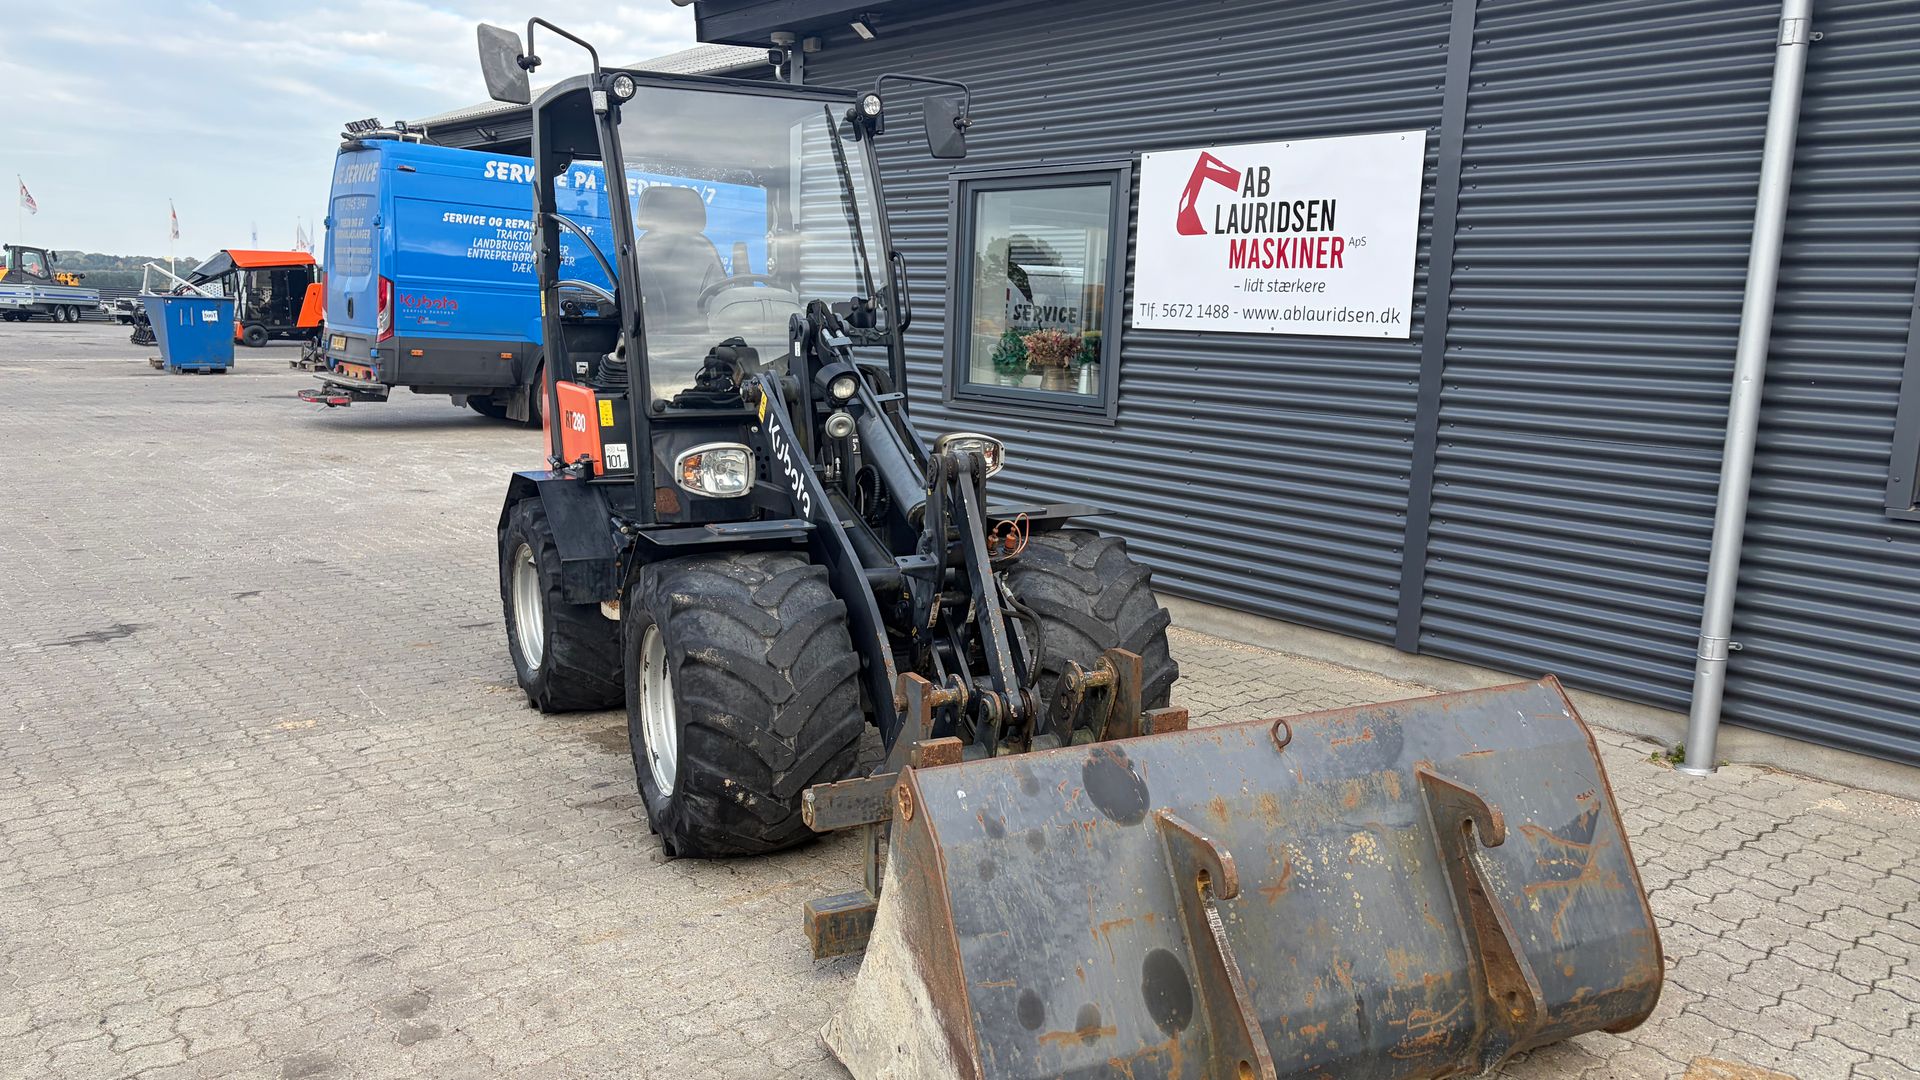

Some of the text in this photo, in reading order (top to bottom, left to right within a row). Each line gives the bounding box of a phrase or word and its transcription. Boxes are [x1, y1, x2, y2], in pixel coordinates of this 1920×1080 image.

[574, 170, 597, 190] PÅ
[1242, 166, 1271, 198] AB
[443, 212, 485, 225] SERVICE
[488, 217, 502, 227] OG
[1215, 199, 1336, 235] LAURIDSEN
[1228, 236, 1367, 269] MASKINER ApS
[1243, 278, 1264, 293] lidt
[1267, 279, 1326, 293] stærkere
[400, 294, 458, 310] Kubota
[1013, 303, 1077, 324] SERVICE
[1140, 303, 1158, 321] Tlf.
[1162, 303, 1193, 319] 5672
[1197, 304, 1229, 319] 1488
[1242, 306, 1400, 325] www.ablauridsen.dk
[606, 454, 622, 468] 101
[768, 412, 811, 519] Kubota
